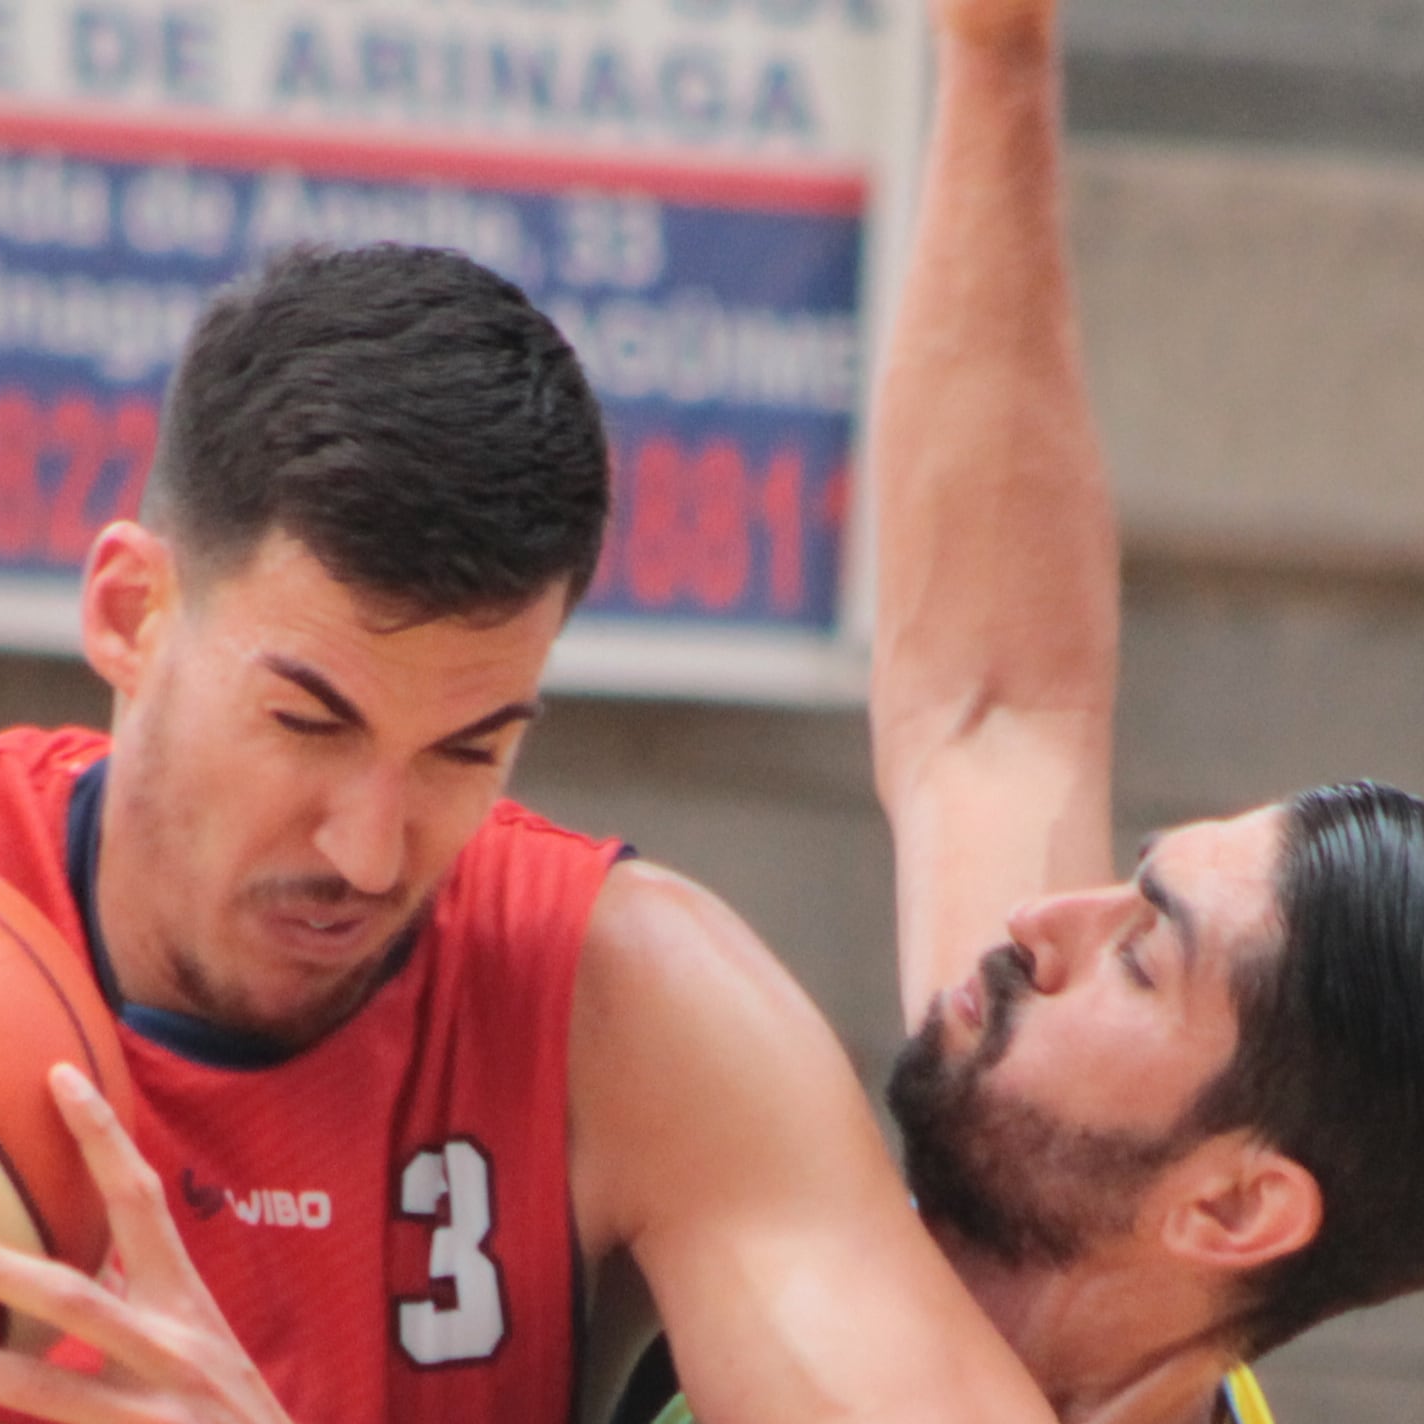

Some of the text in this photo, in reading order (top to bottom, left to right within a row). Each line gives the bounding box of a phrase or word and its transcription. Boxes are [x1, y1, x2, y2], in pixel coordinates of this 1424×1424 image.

[73, 5, 216, 100] DE
[274, 28, 823, 137] ARINAGA
[119, 157, 238, 262] de
[390, 1134, 514, 1373] 3
